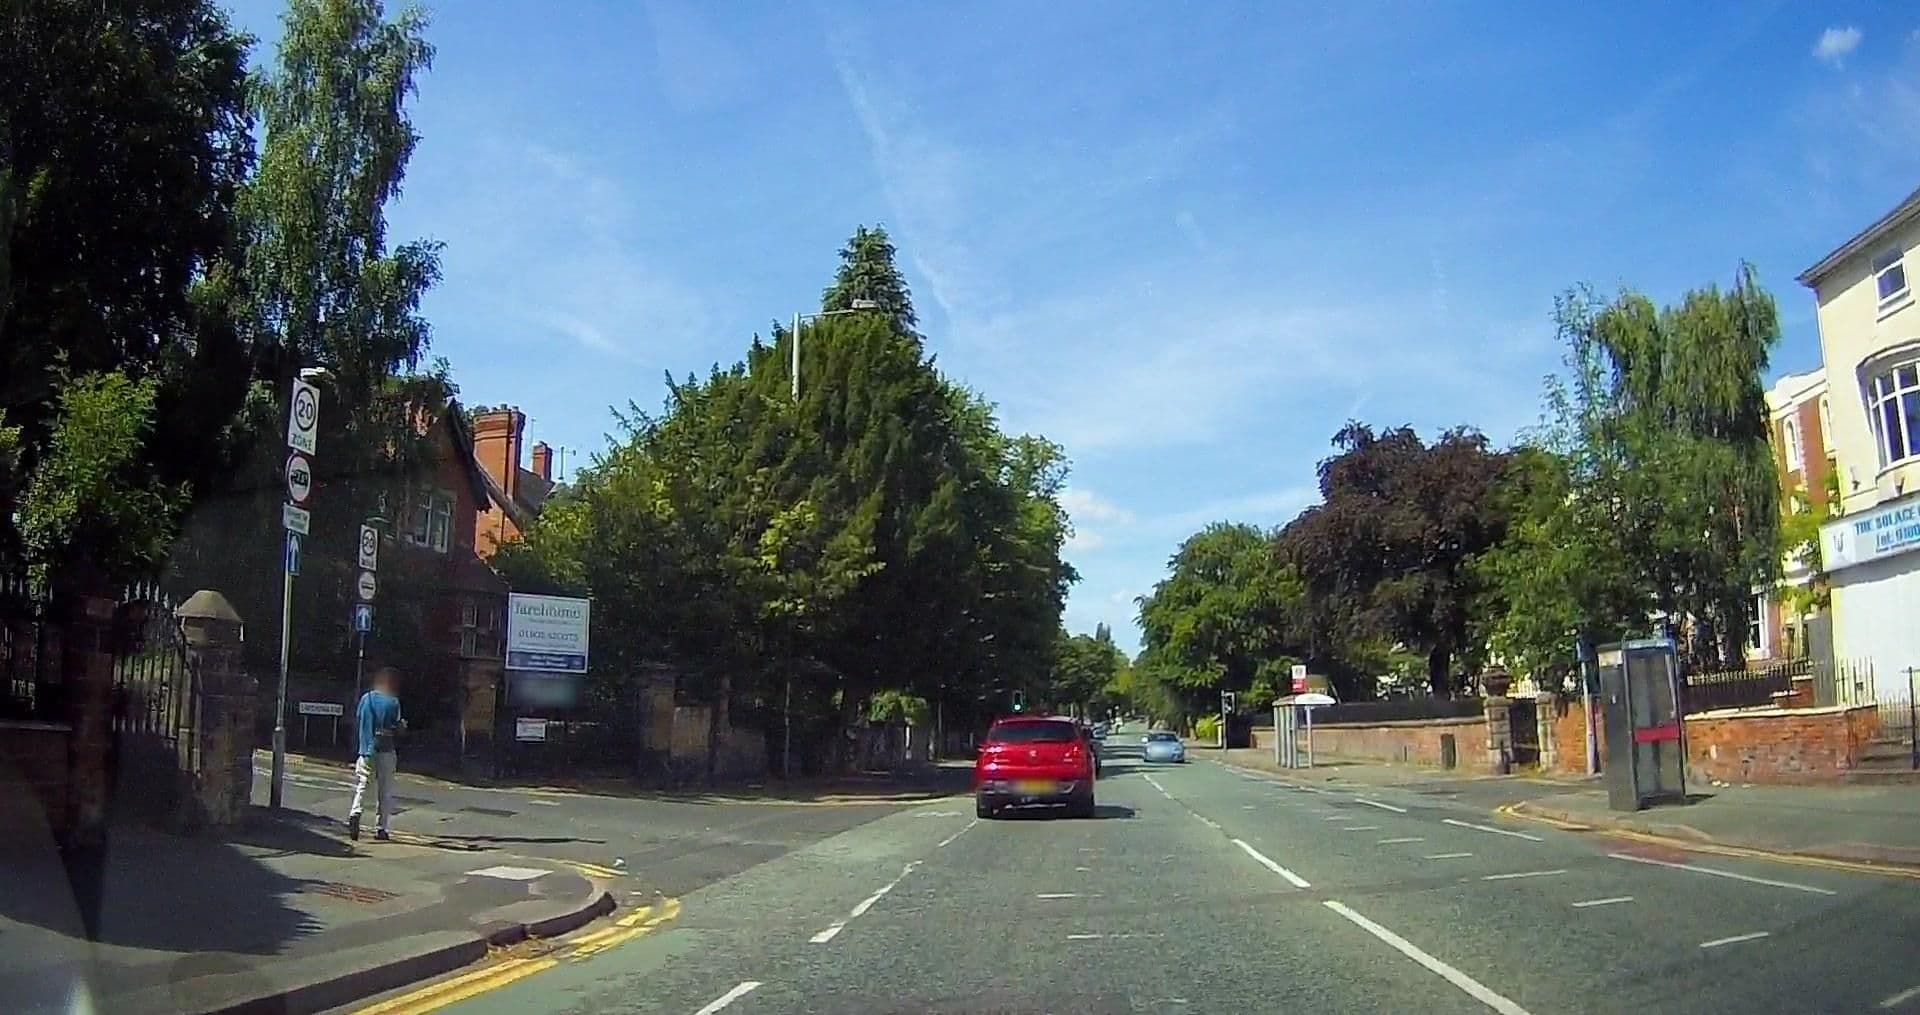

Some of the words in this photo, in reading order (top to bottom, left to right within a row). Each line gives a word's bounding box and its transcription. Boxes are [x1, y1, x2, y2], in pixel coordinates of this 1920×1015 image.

[298, 399, 313, 420] 20
[292, 433, 312, 451] ZONE
[1855, 519, 1872, 535] THE
[1876, 506, 1916, 528] SOLACE
